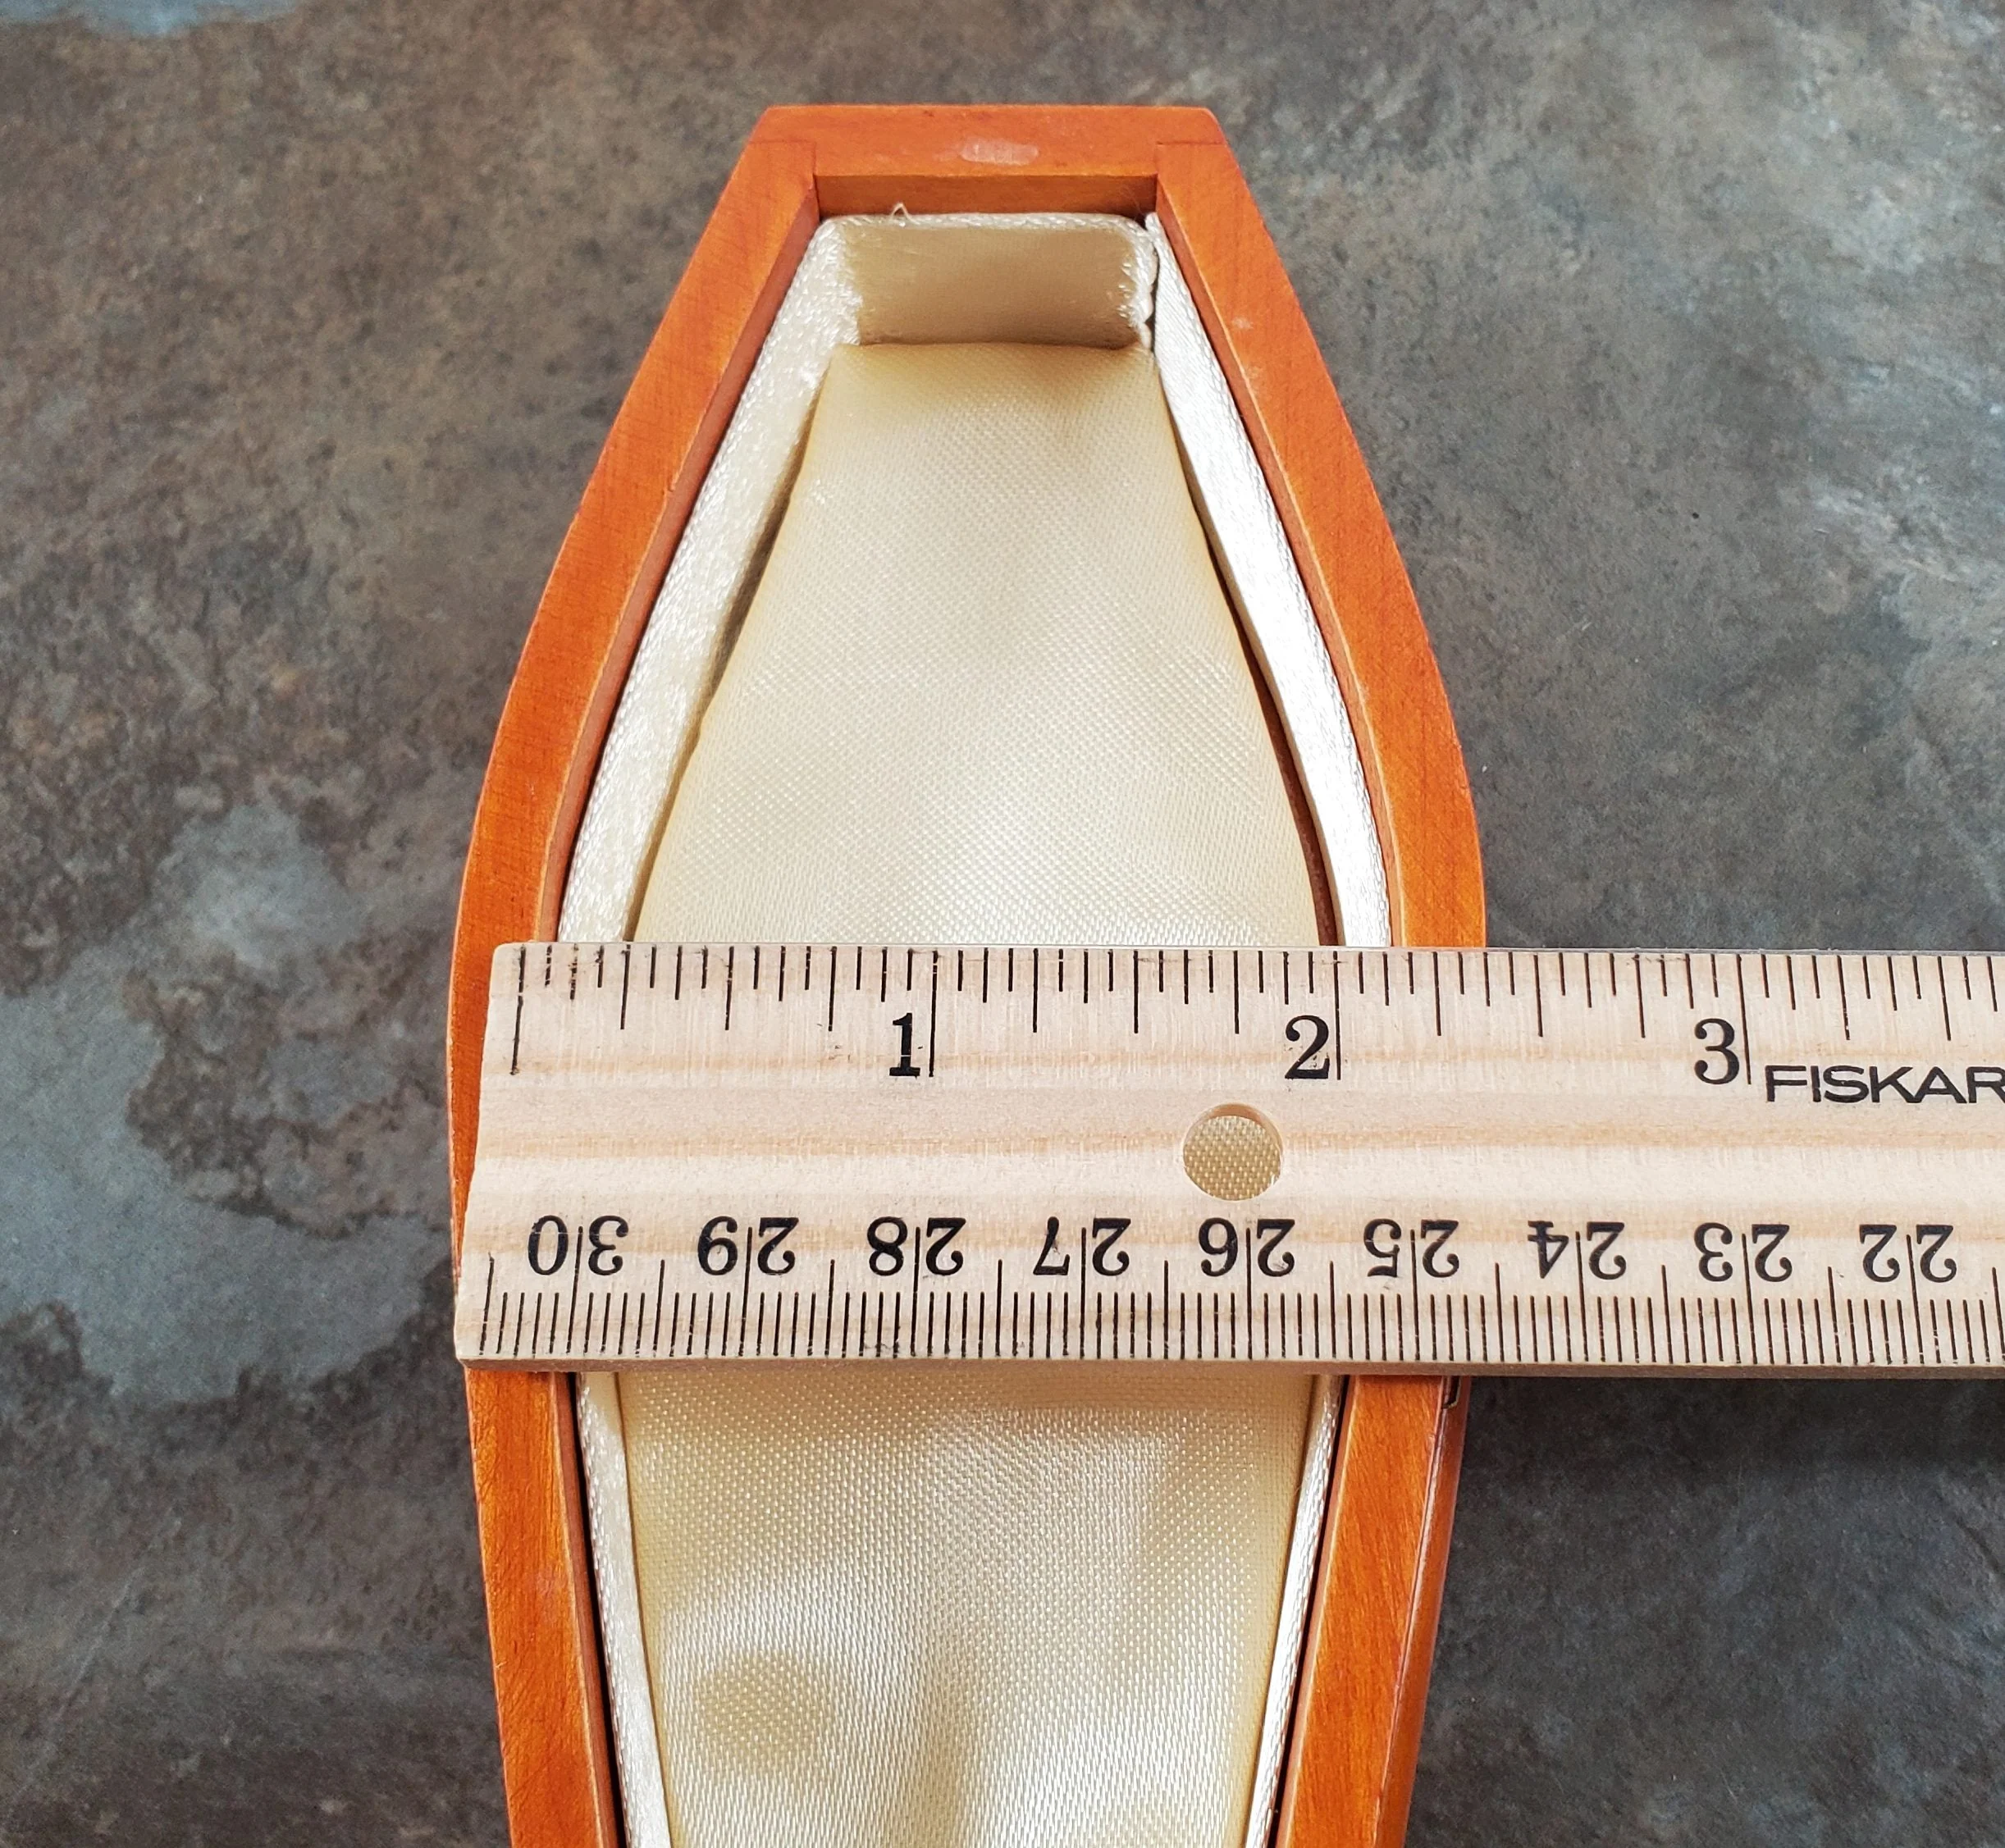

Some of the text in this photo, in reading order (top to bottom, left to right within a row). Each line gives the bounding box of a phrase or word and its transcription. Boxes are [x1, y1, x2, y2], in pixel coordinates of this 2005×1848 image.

[889, 1012, 921, 1079] 1
[1284, 1015, 1331, 1080] 2
[1694, 1018, 1740, 1085] 3
[1765, 1065, 2005, 1104] FISKAR
[528, 1215, 628, 1276] 30
[697, 1216, 799, 1276] 29
[867, 1216, 966, 1277] 28
[1033, 1216, 1130, 1277] 27
[1199, 1217, 1295, 1278] 26
[1363, 1218, 1459, 1279] 25
[1528, 1220, 1626, 1280] 24
[1694, 1222, 1792, 1283] 23
[1860, 1224, 1957, 1284] 22
